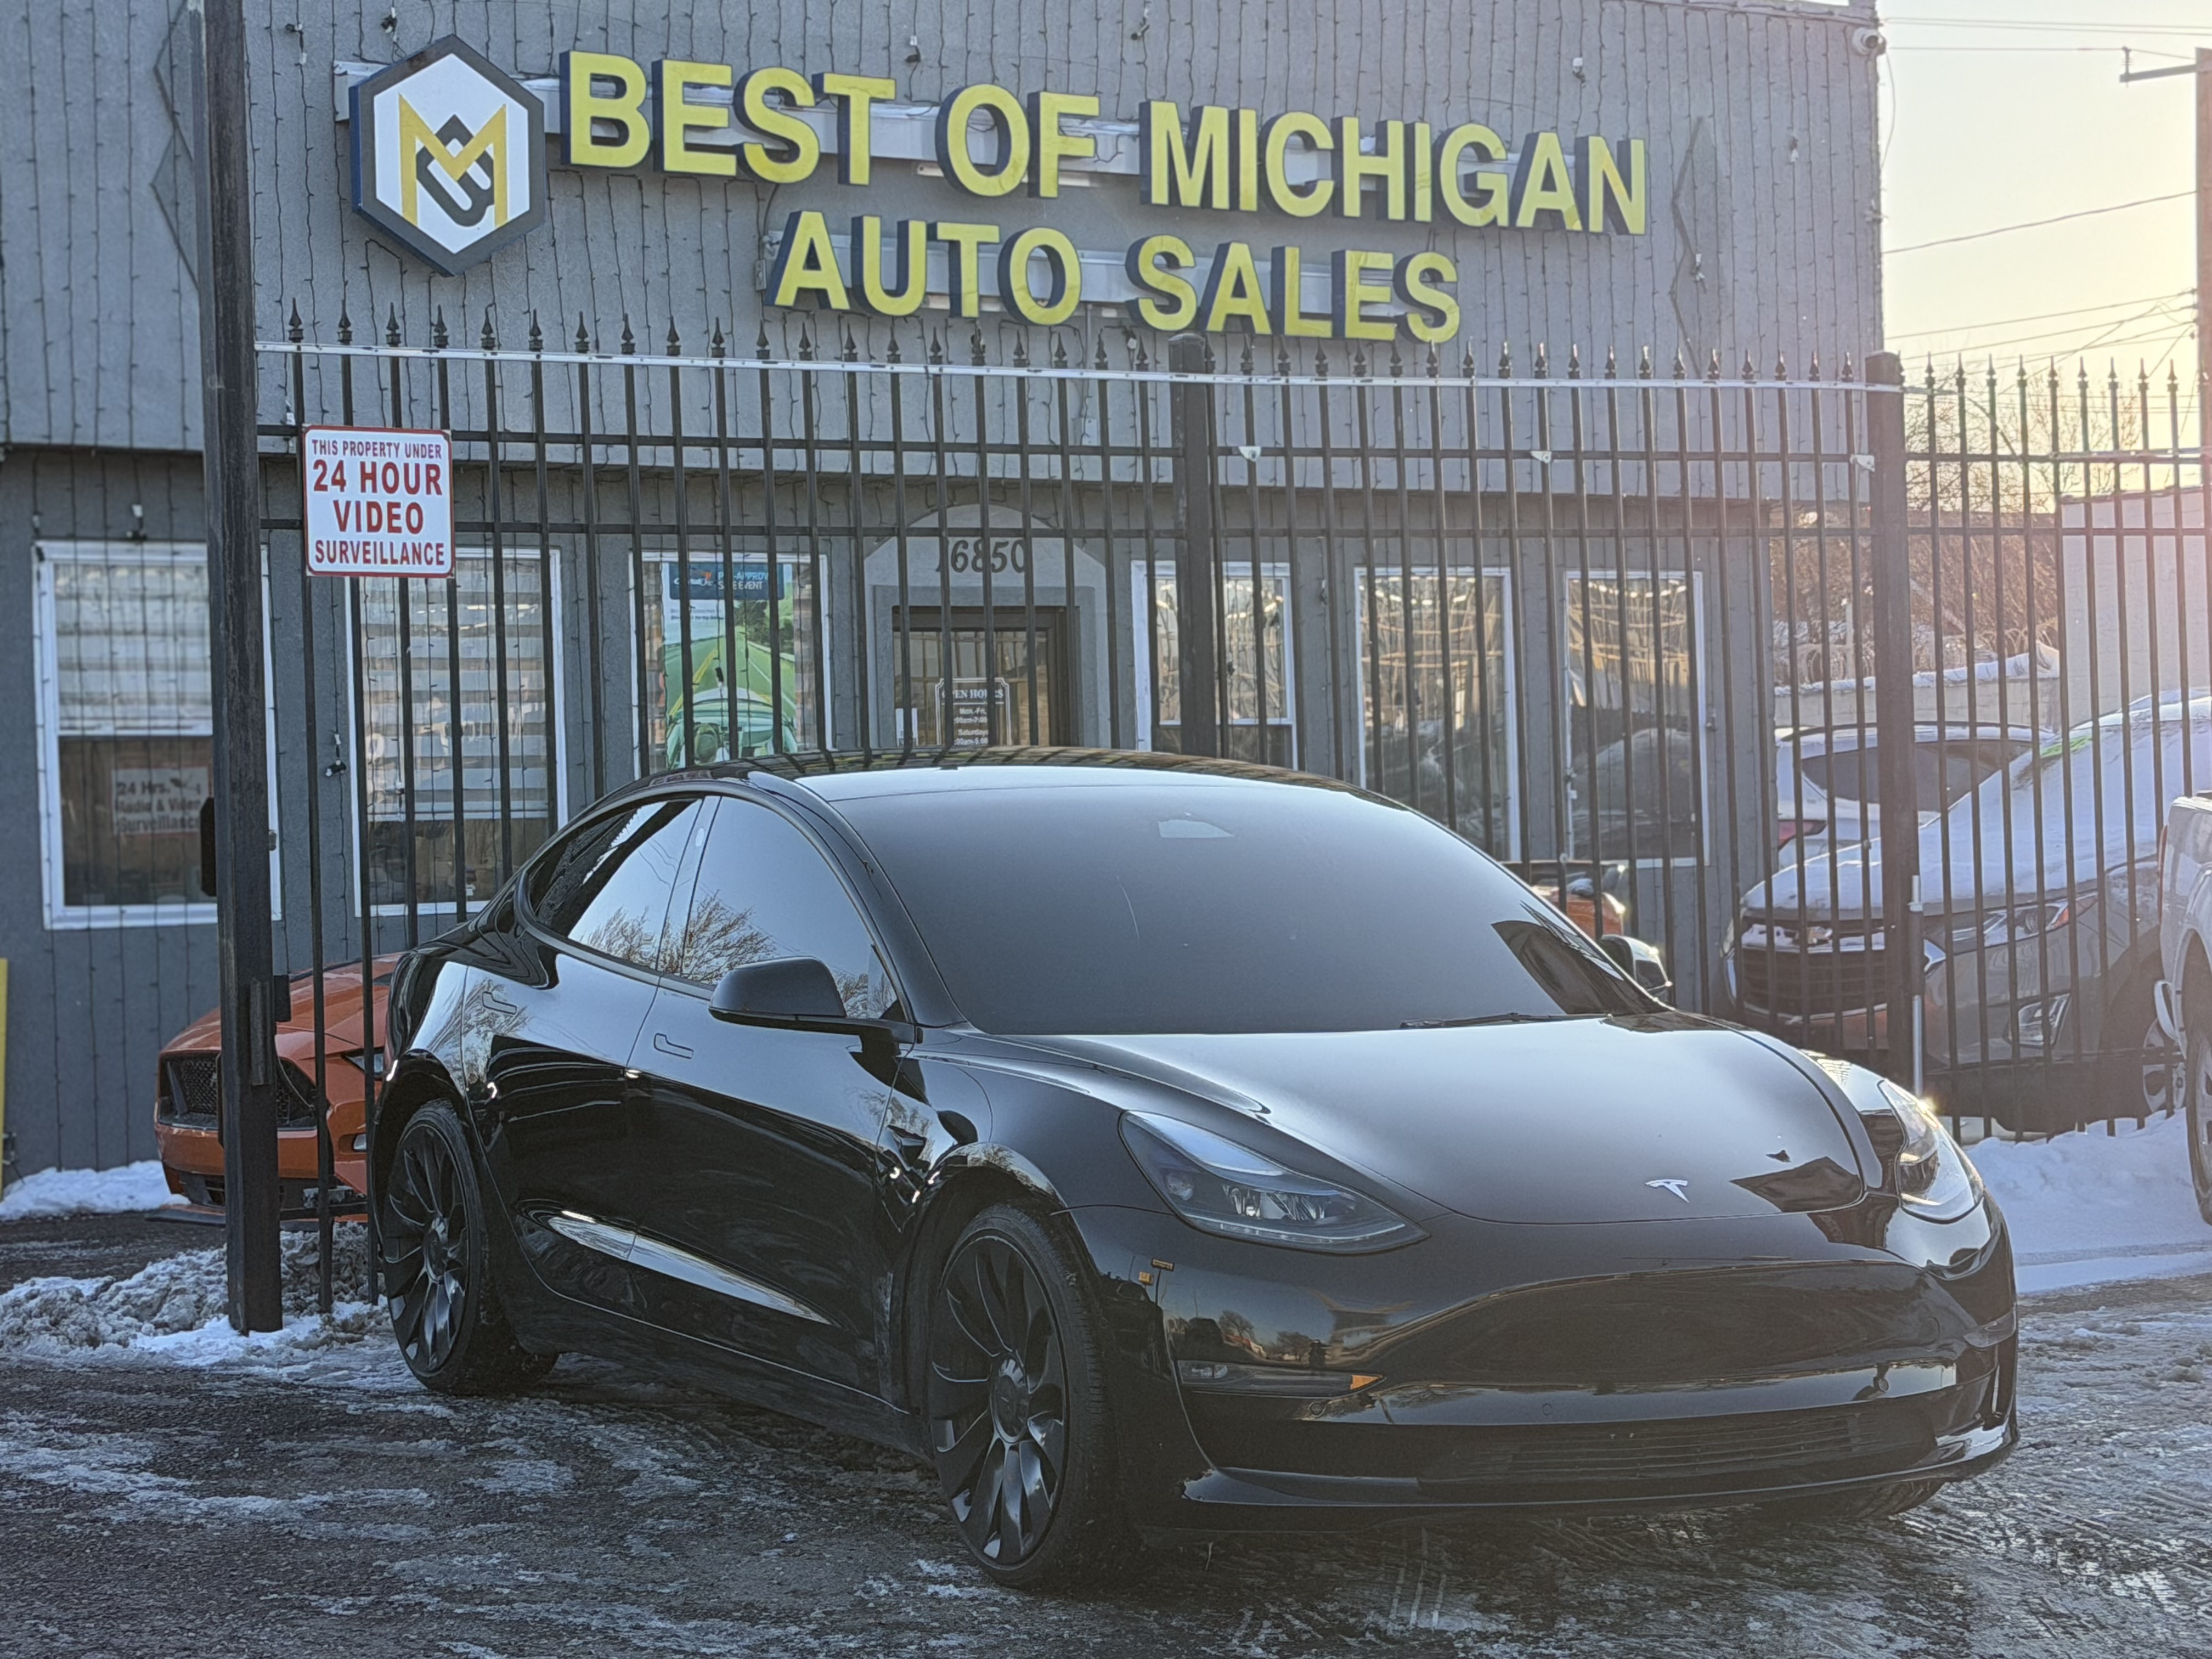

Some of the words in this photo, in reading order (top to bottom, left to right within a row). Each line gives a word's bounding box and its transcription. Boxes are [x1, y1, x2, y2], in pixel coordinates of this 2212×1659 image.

[565, 50, 896, 185] BEST
[941, 83, 1099, 198] OF
[1147, 100, 1646, 235] MICHIGAN
[771, 210, 1082, 326] AUTO
[1133, 234, 1460, 343] SALES
[312, 439, 338, 455] THIS
[342, 440, 400, 459] PROPERTY
[404, 442, 442, 459] UNDER
[312, 459, 347, 493] 24
[359, 461, 443, 496] HOUR
[332, 499, 424, 535] VIDEO
[315, 539, 445, 566] SURVEILLANCE
[117, 782, 136, 795] 24
